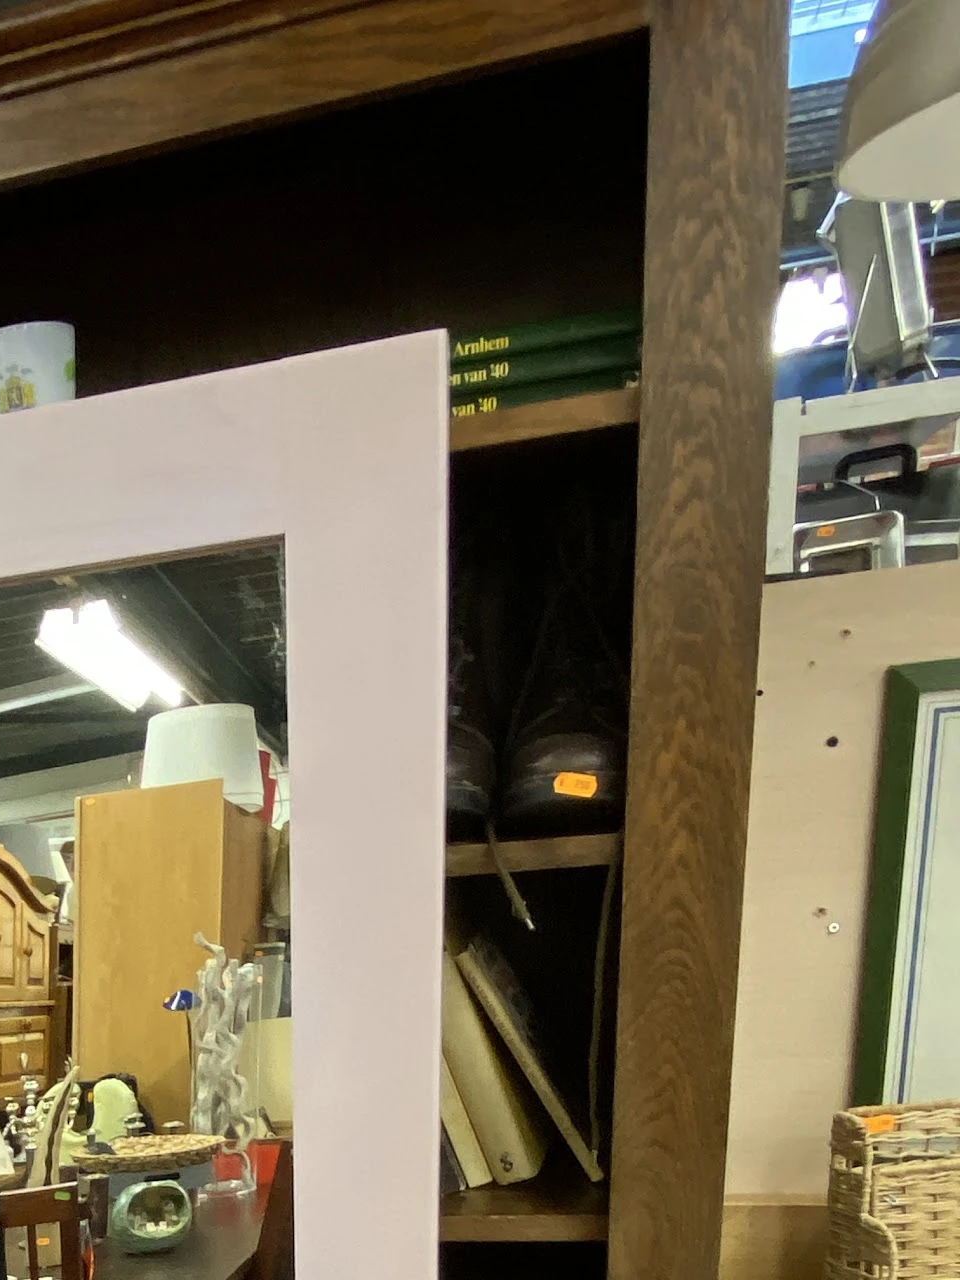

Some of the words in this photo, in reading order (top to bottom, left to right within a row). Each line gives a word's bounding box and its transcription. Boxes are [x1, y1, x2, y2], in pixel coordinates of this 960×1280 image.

[453, 336, 509, 357] Arnhem
[464, 369, 487, 384] van
[452, 403, 475, 417] van
